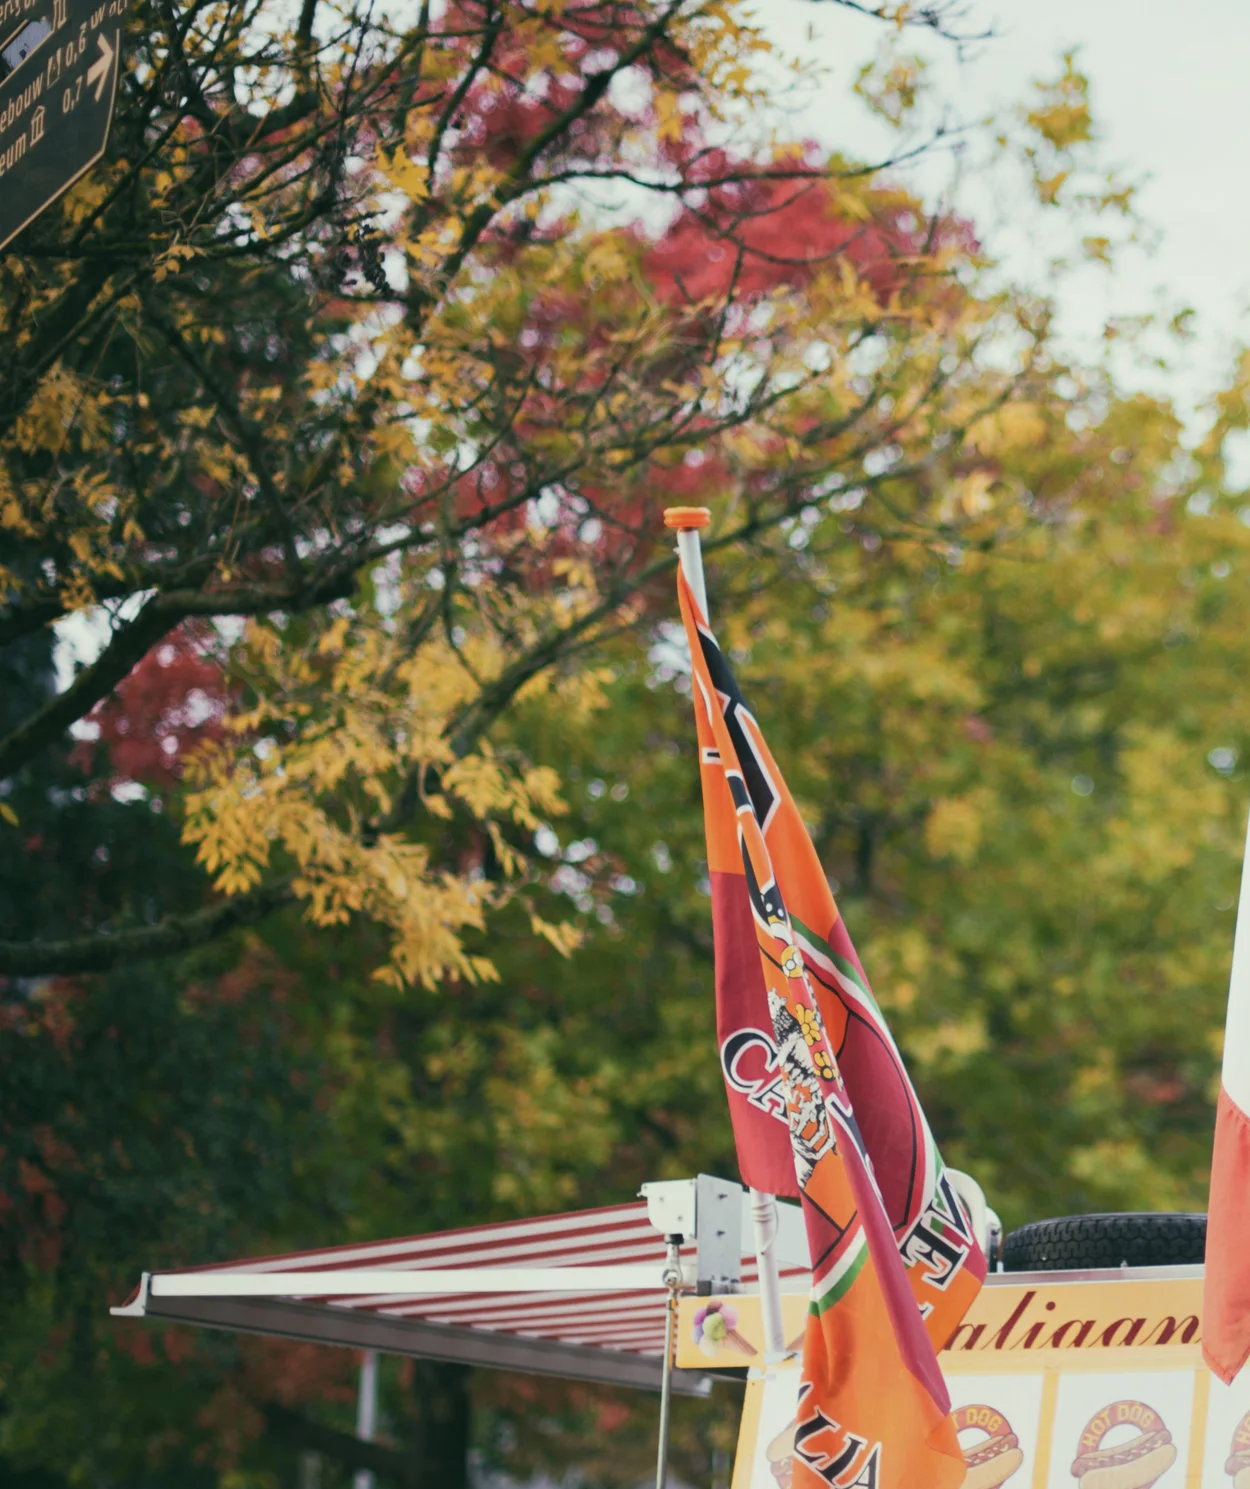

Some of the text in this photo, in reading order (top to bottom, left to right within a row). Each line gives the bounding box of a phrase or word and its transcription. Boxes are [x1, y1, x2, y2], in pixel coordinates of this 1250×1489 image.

[966, 1408, 1003, 1432] DOG
[1083, 1403, 1155, 1447] HOT DOG
